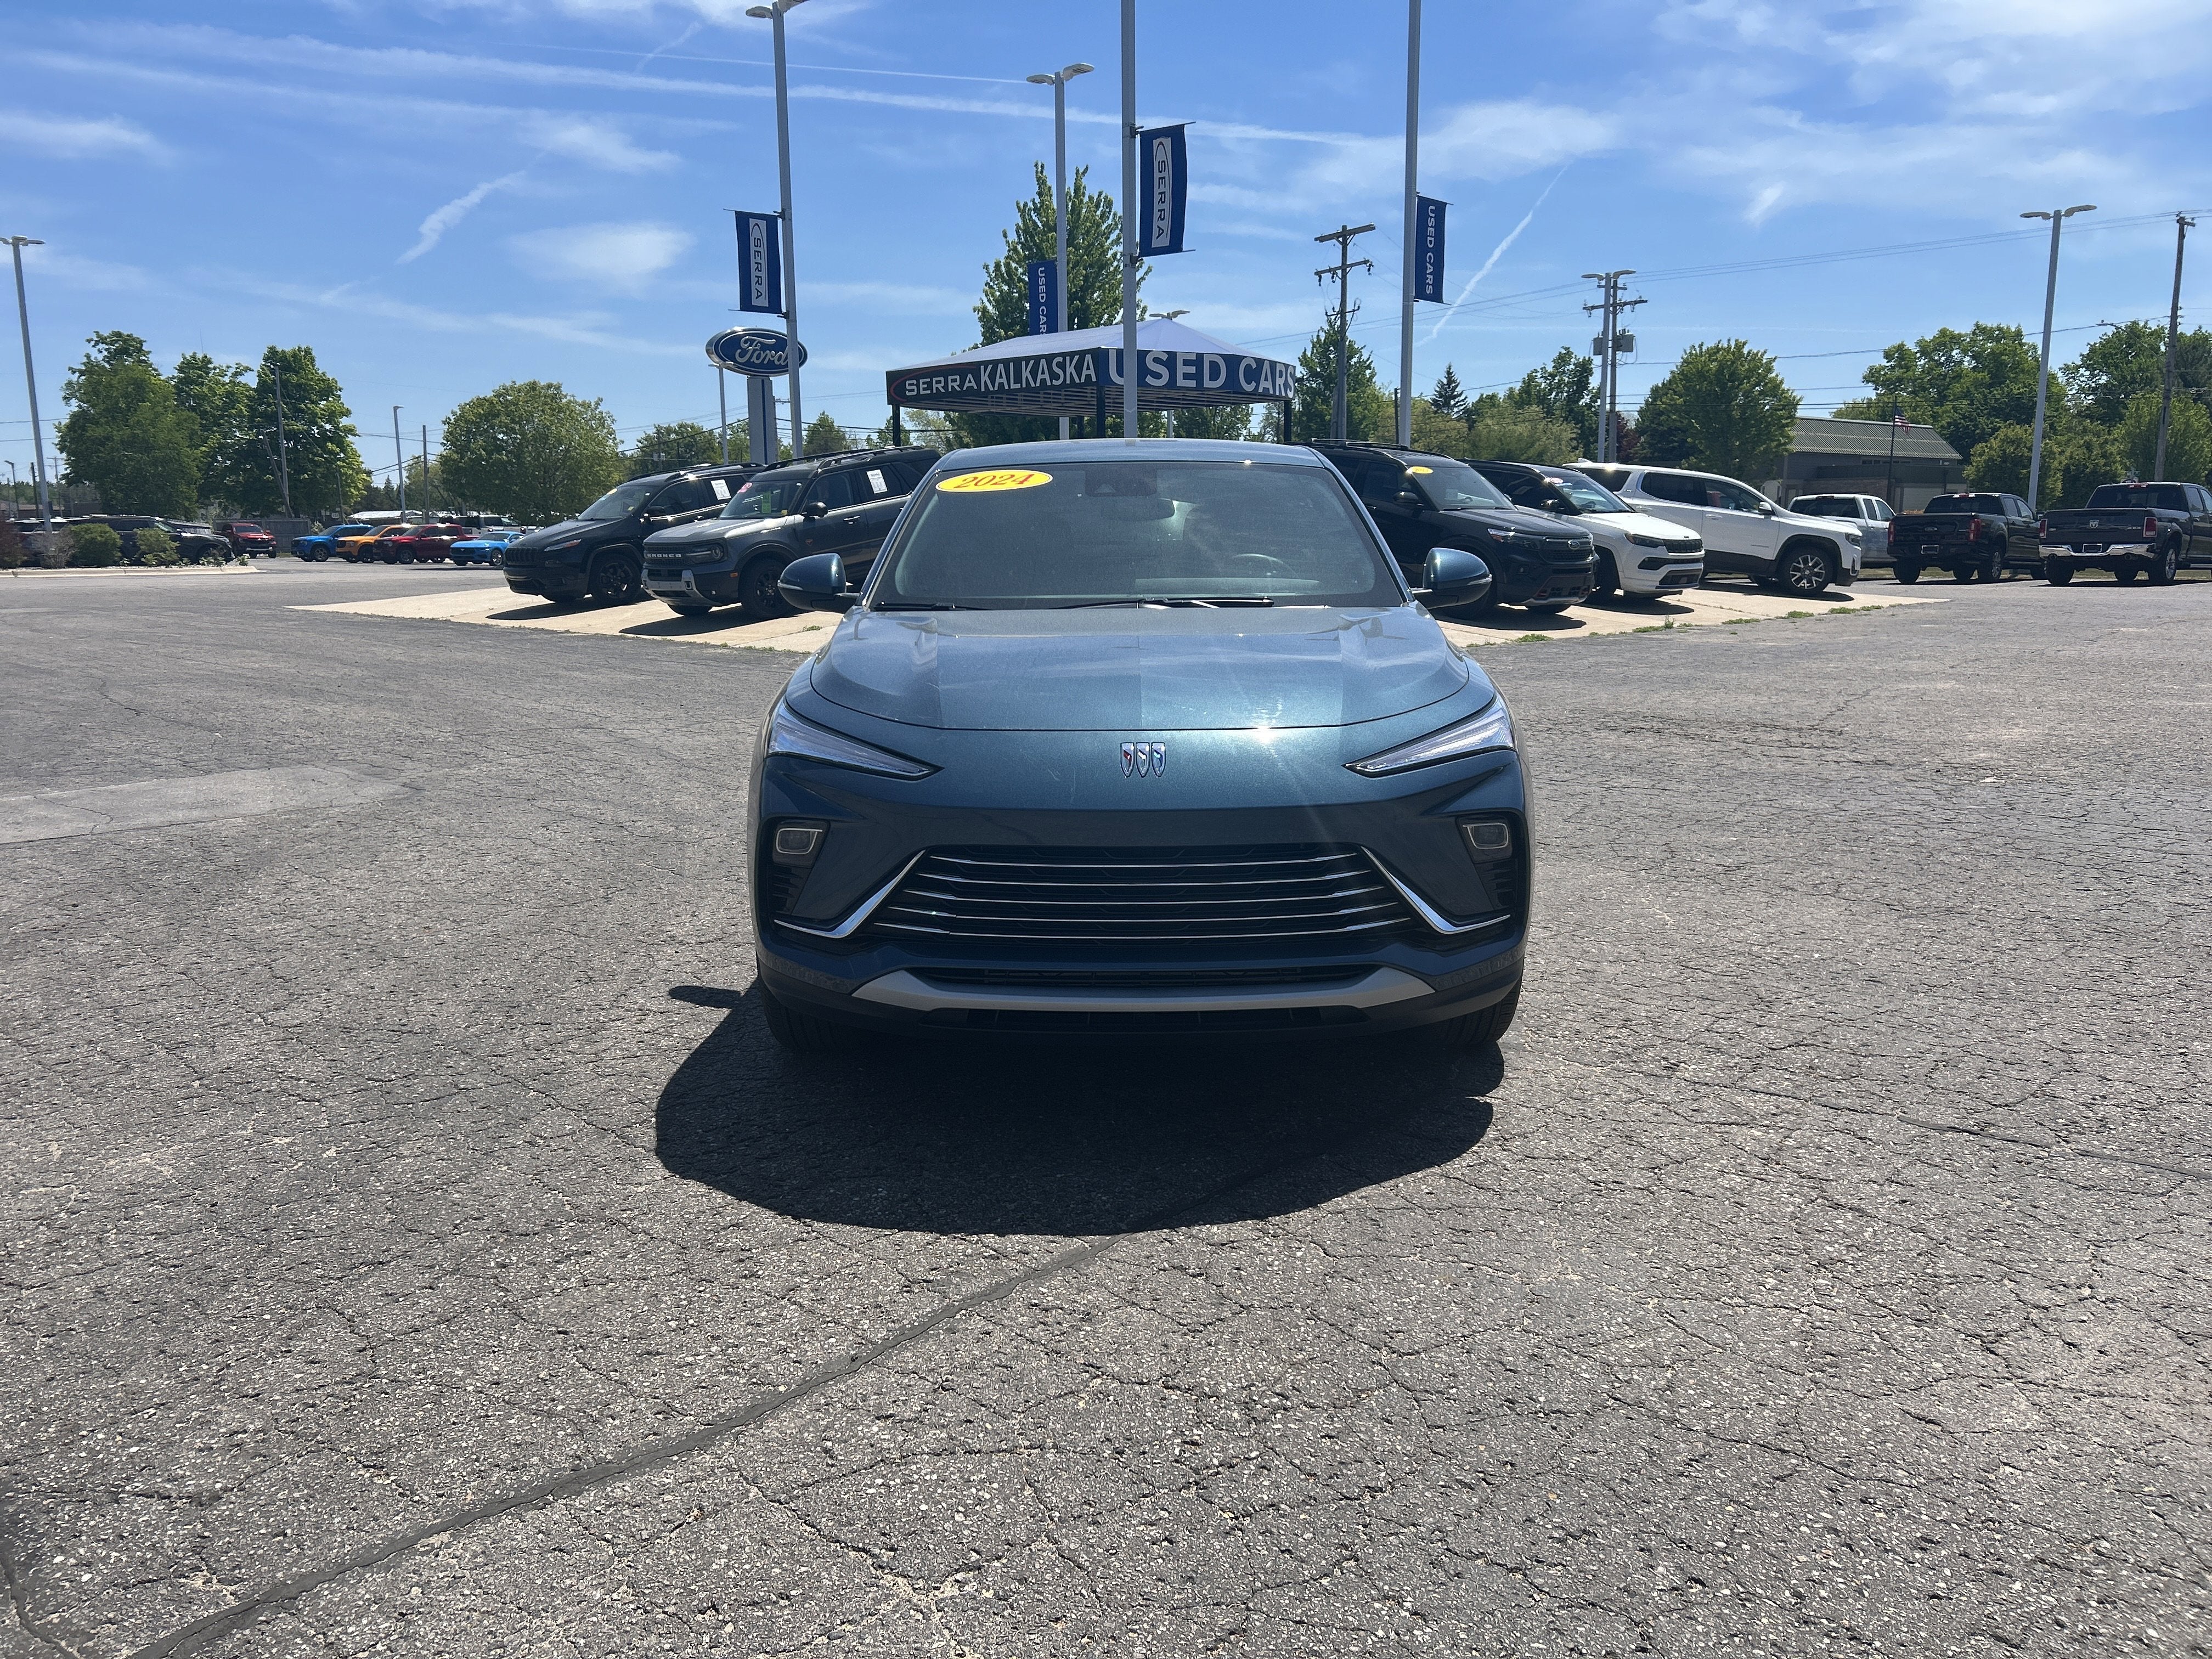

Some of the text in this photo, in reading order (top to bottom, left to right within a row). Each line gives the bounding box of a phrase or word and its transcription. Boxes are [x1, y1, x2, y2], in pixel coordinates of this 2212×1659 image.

[1155, 160, 1166, 240] SERRA
[753, 236, 763, 300] SERRA
[1426, 205, 1436, 295] USED CARS
[1038, 267, 1046, 303] USED
[735, 336, 789, 366] Ford
[905, 354, 1097, 396] SERRA KALKASKA
[1238, 357, 1295, 398] CARS
[953, 473, 1035, 489] 2024
